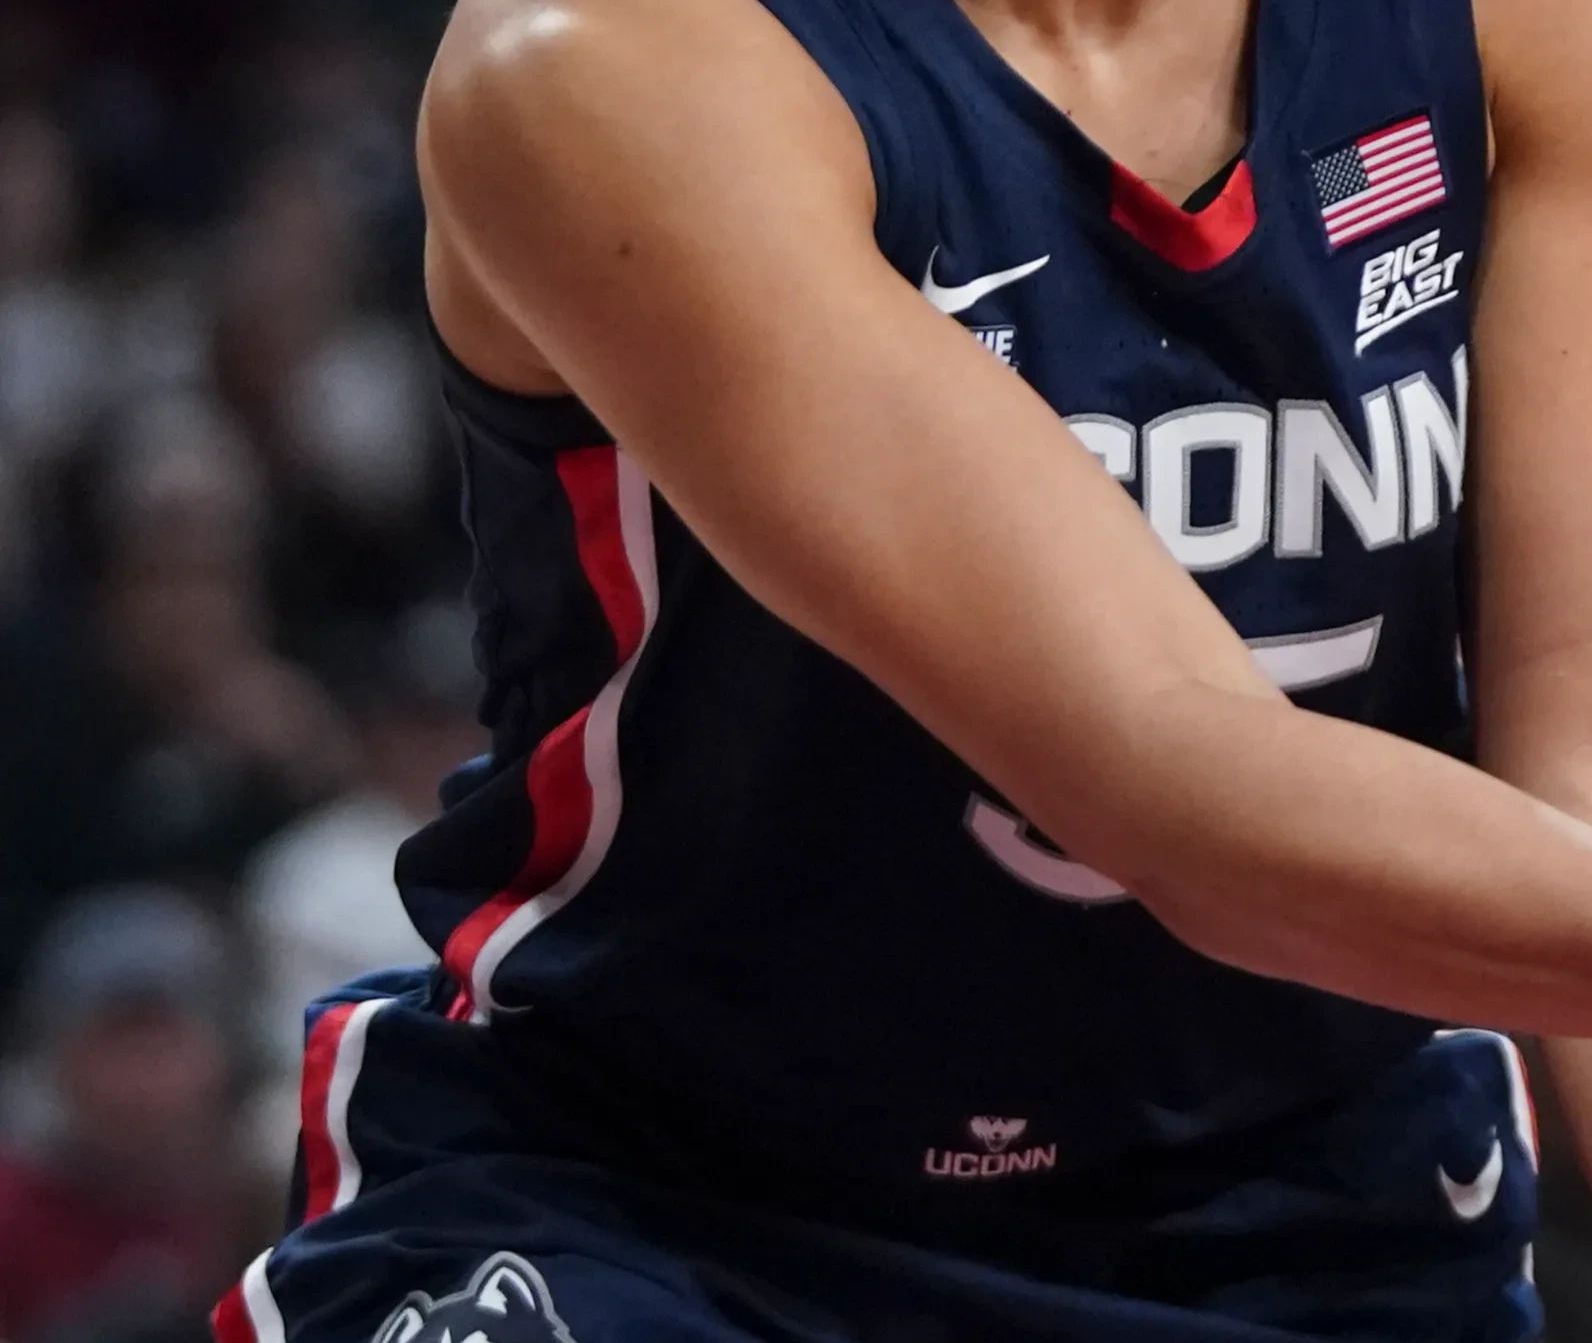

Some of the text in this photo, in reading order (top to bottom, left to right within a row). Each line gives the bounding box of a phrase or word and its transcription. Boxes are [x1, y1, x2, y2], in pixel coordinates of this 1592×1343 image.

[1356, 250, 1465, 333] EAST
[1361, 228, 1441, 297] BIG
[924, 1142, 1057, 1176] UCONN
